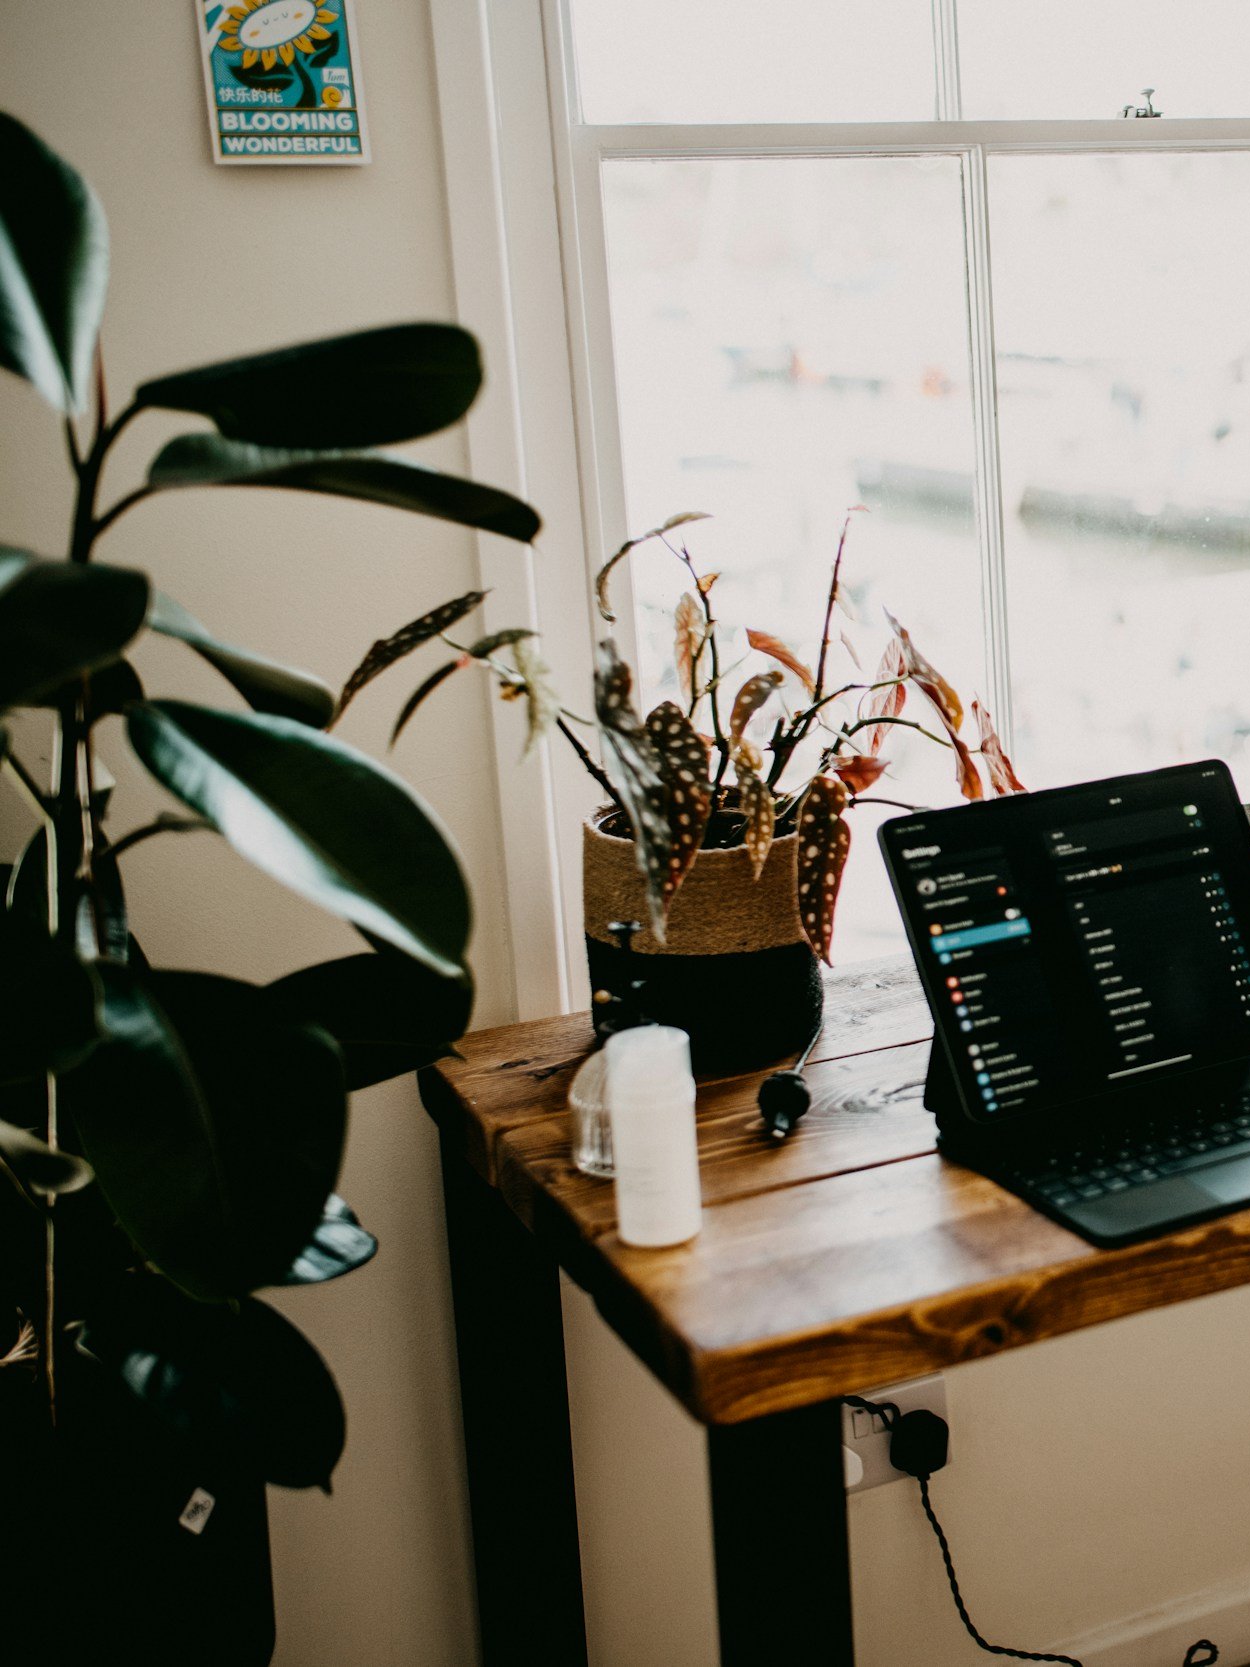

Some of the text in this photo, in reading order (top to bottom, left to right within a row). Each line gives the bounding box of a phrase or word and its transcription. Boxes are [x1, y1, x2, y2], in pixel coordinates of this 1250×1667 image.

[218, 86, 284, 104] 快乐的花
[221, 111, 354, 131] BLOOMING
[224, 136, 360, 153] WONDERFUL
